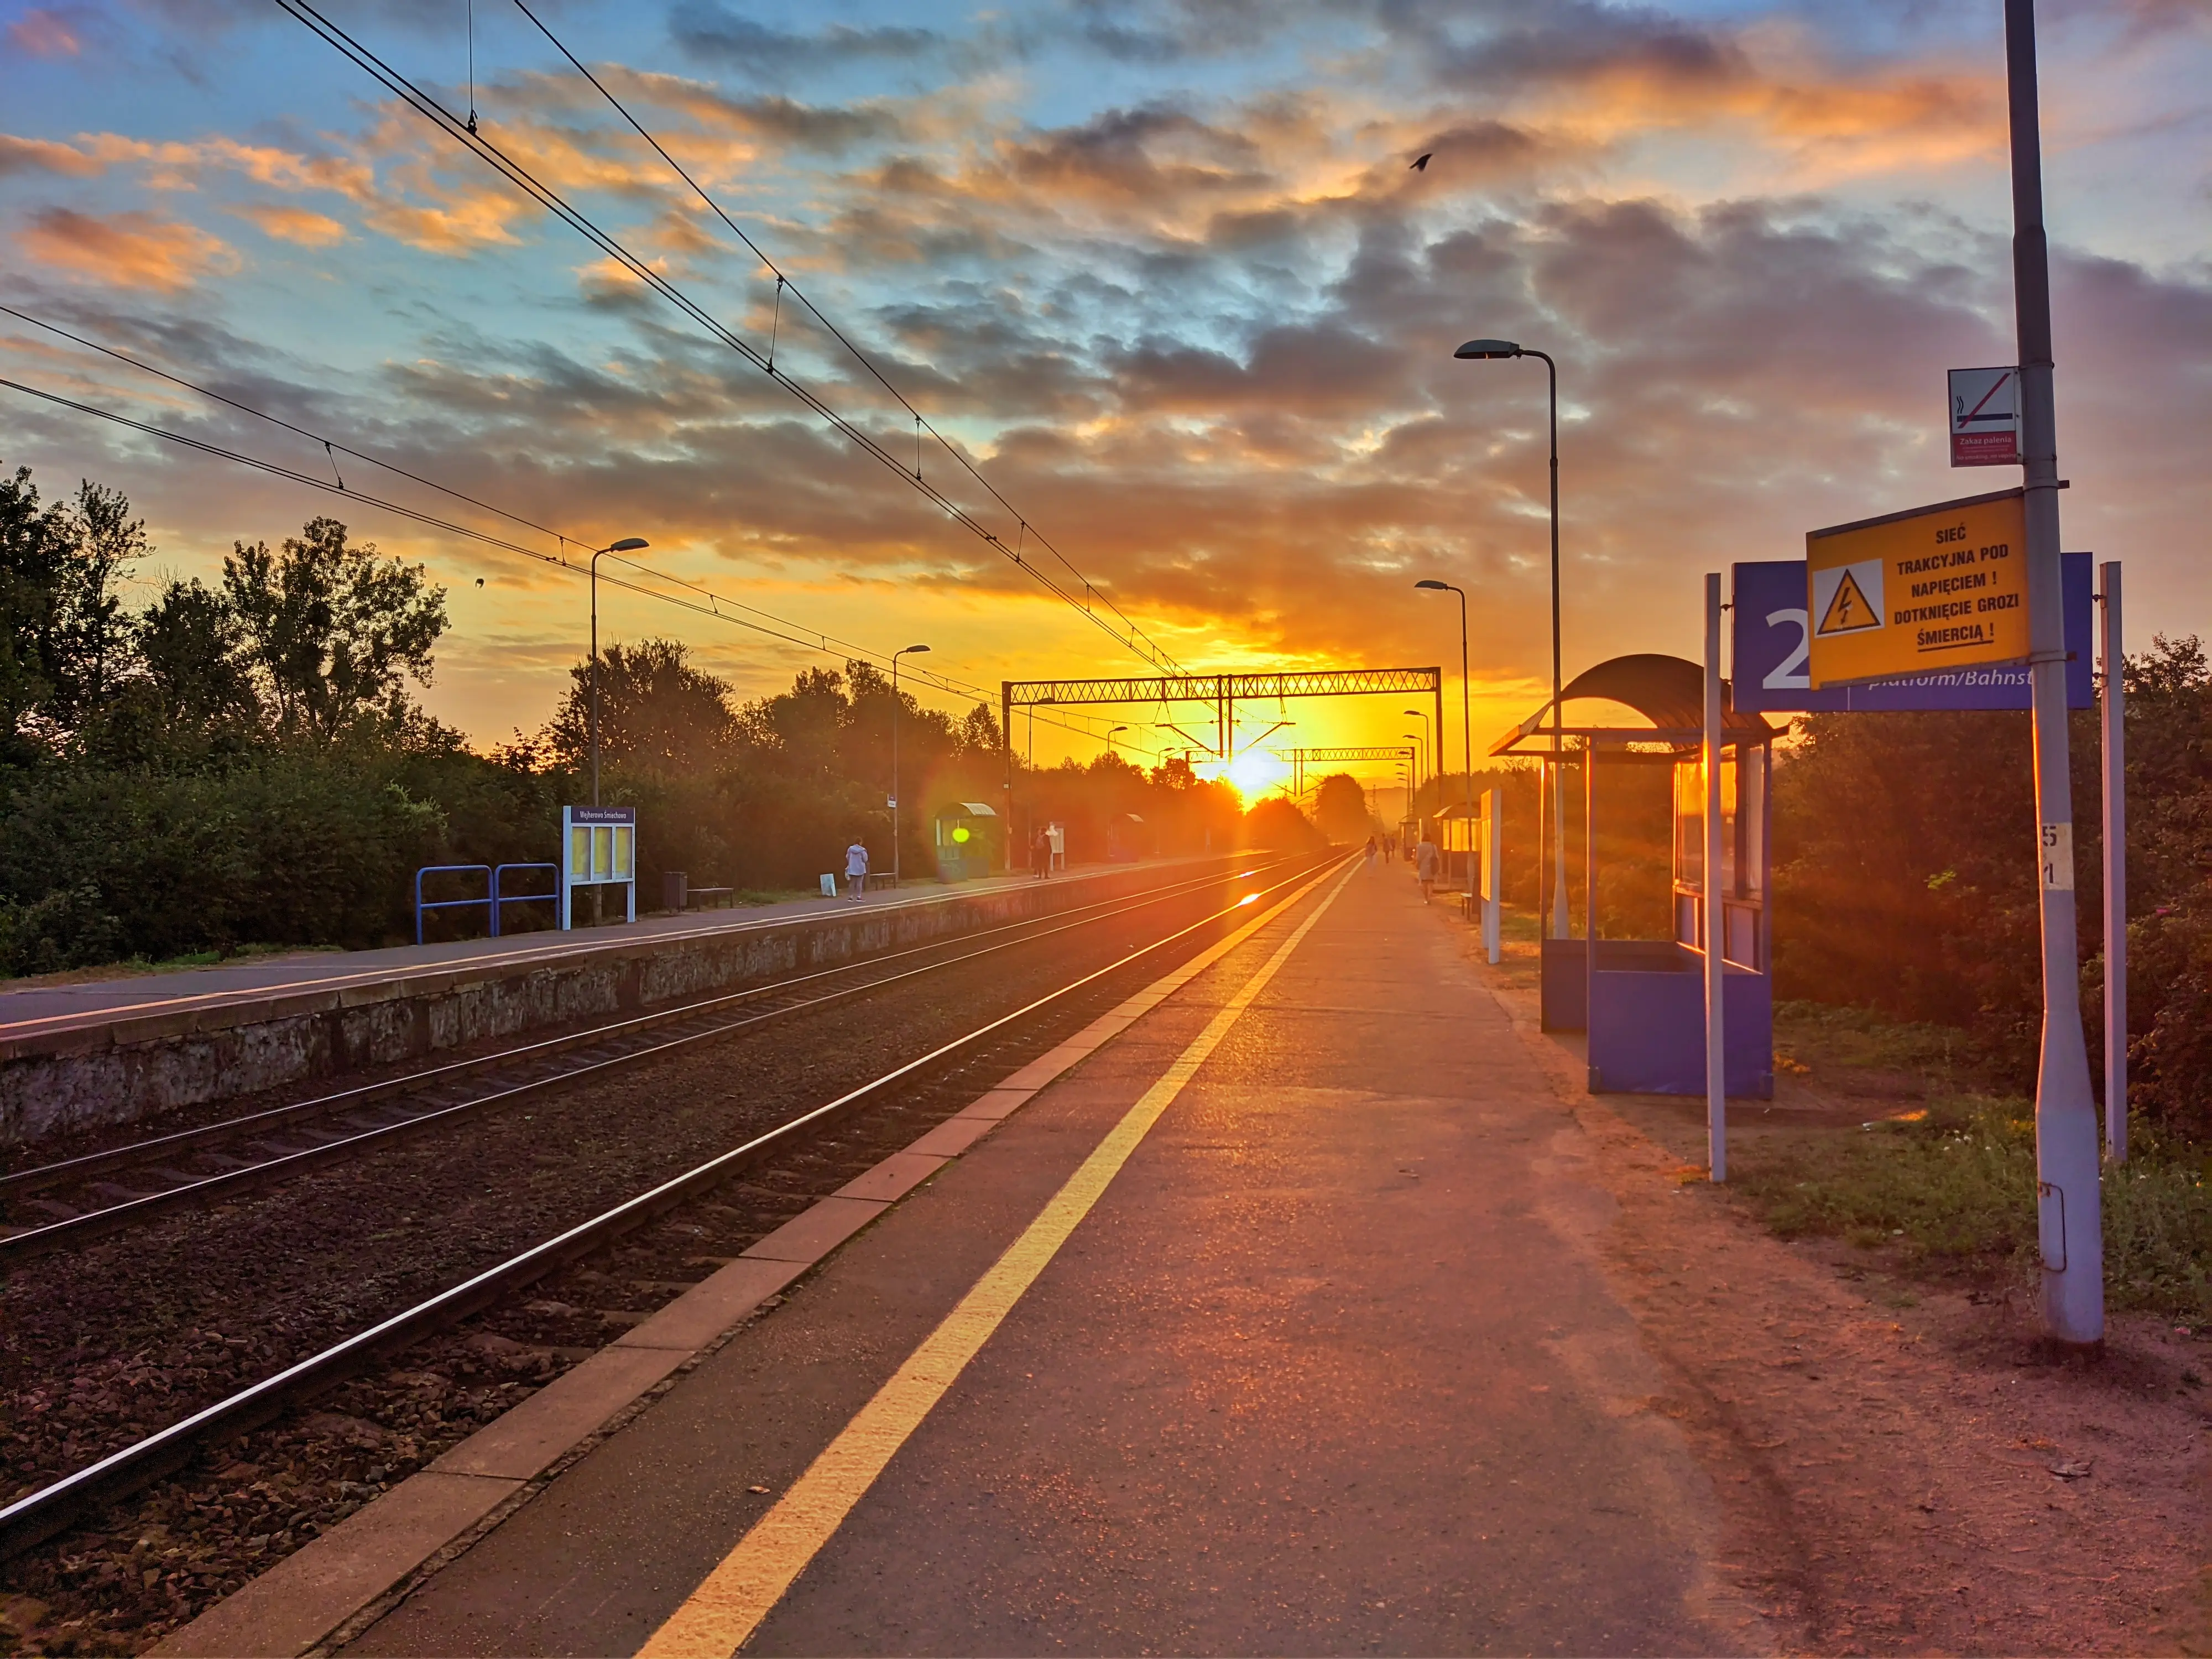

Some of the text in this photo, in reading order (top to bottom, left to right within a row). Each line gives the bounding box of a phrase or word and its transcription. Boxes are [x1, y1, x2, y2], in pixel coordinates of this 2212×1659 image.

[1984, 436, 2012, 445] palenia
[1936, 522, 1966, 544] SIEĆ
[1897, 544, 2008, 575] TRAKCYJNA POD
[1912, 571, 1997, 598] NAPIĘCIEM !
[1894, 593, 2019, 625] DOTKNIĘCIE GROZI
[1917, 623, 1994, 646] ŚMIERCIĄ !
[1762, 608, 1810, 690] 2
[580, 810, 627, 820] Wejherowo Śmiechowo
[2042, 825, 2057, 847] 5
[2043, 863, 2054, 884] 1
